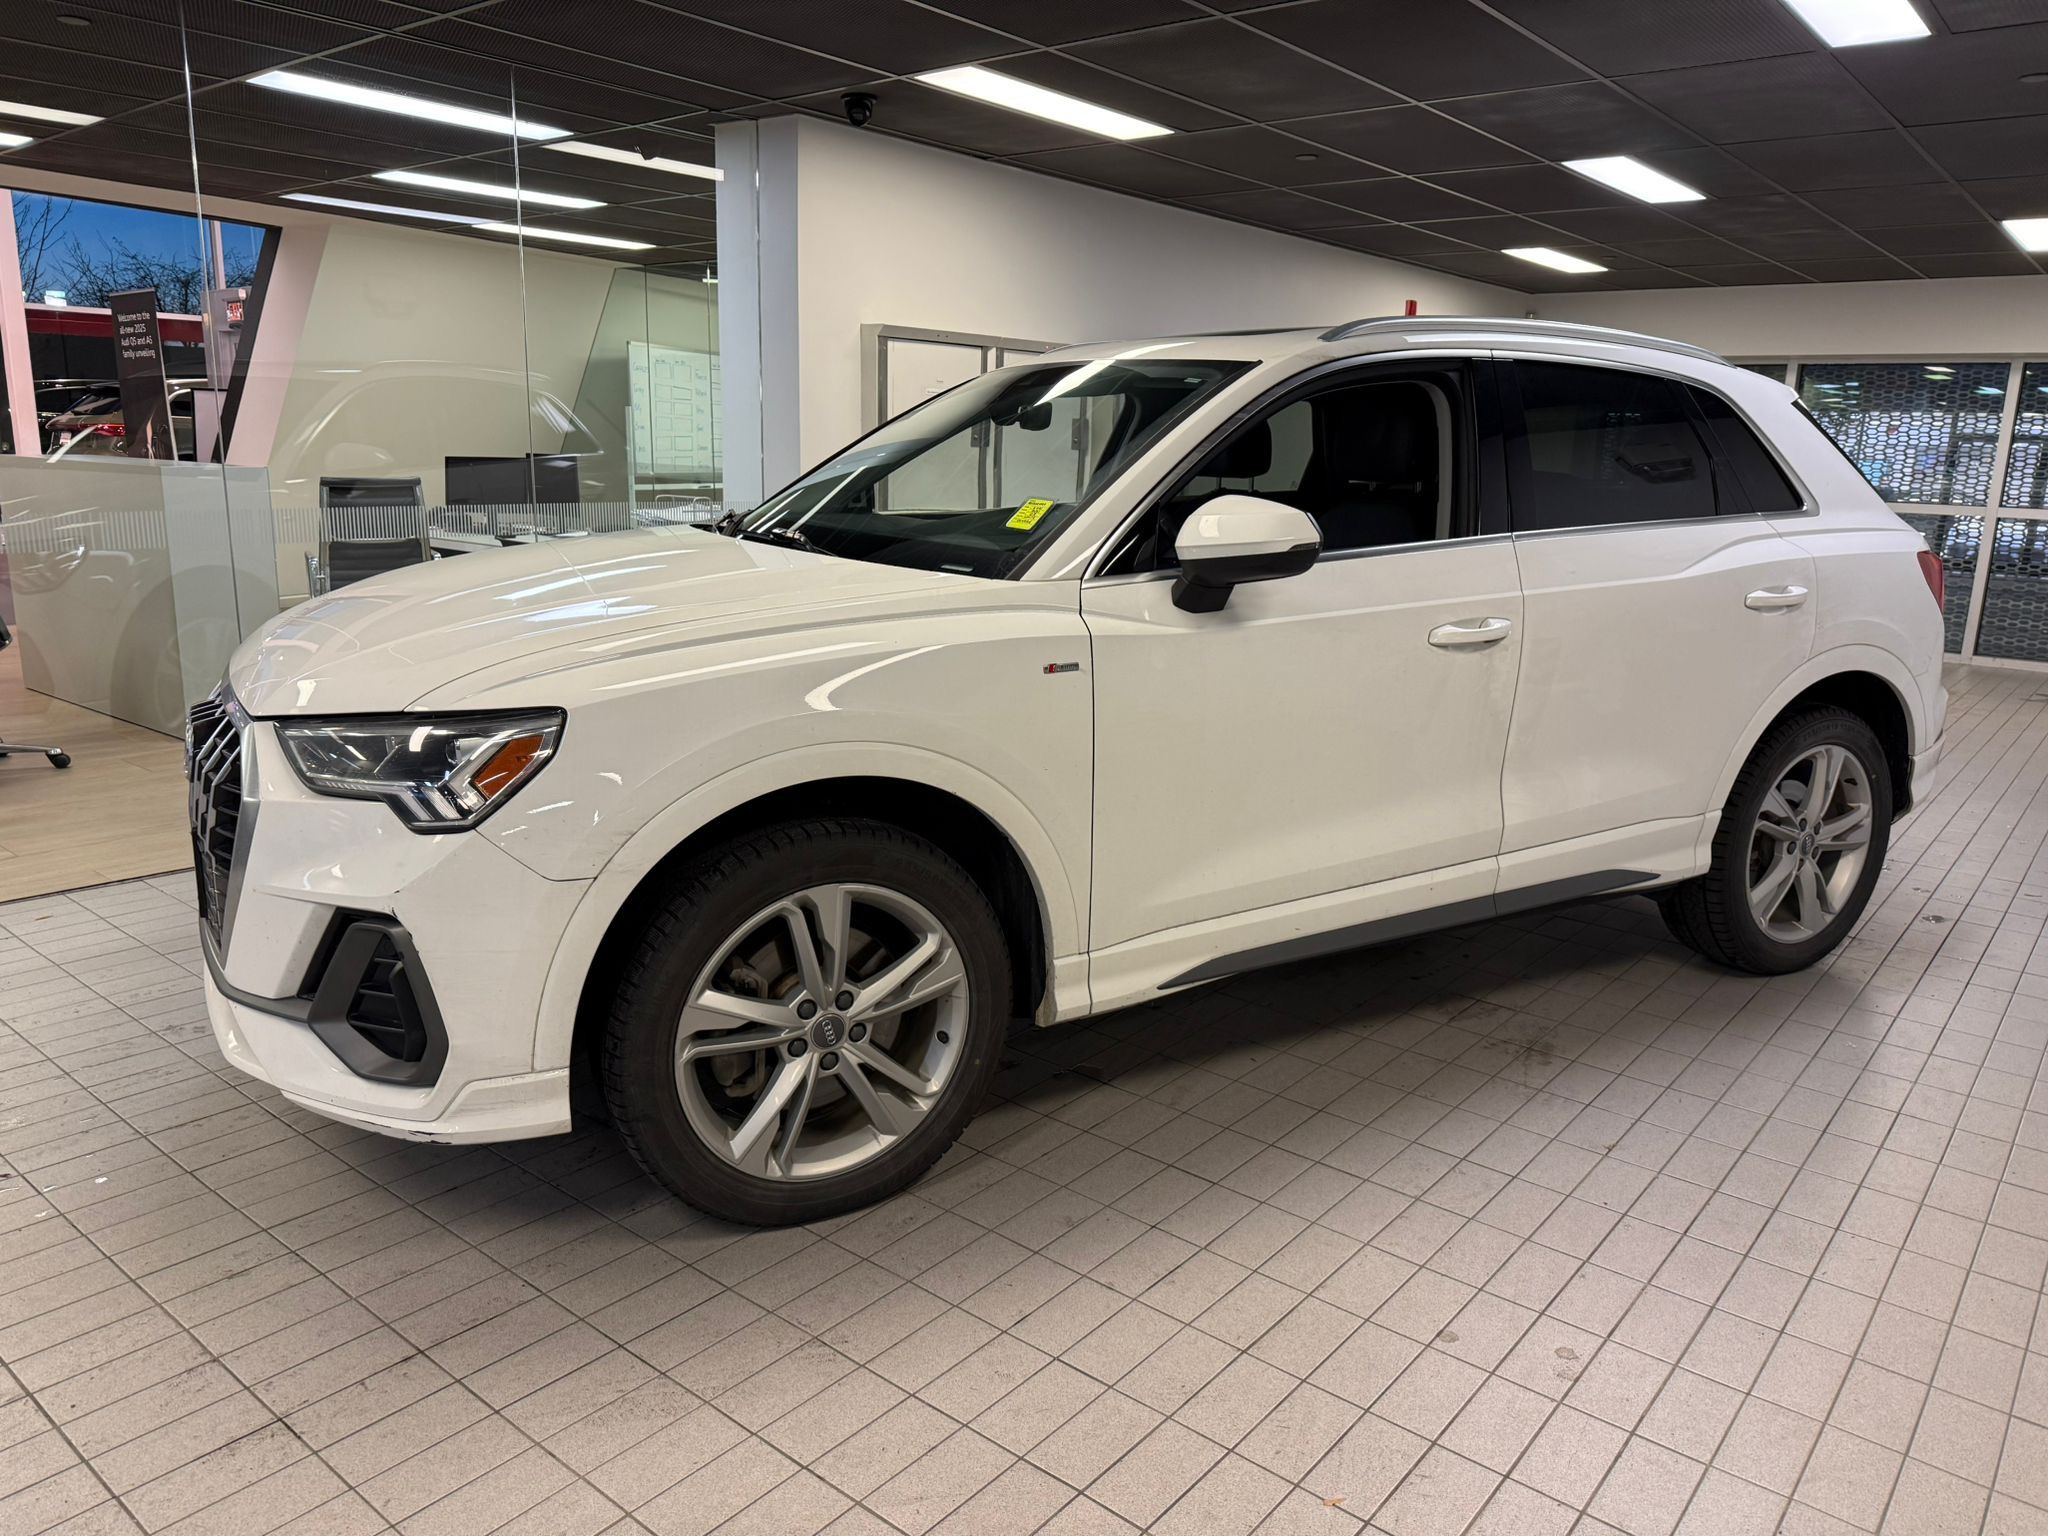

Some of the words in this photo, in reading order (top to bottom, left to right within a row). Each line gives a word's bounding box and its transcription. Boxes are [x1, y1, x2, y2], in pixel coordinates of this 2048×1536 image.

[117, 313, 136, 322] Welcome
[142, 312, 151, 320] the
[134, 323, 146, 333] 2025
[121, 337, 130, 346] Audi
[137, 336, 145, 345] and
[122, 349, 135, 359] family
[136, 348, 156, 359] unveiling
